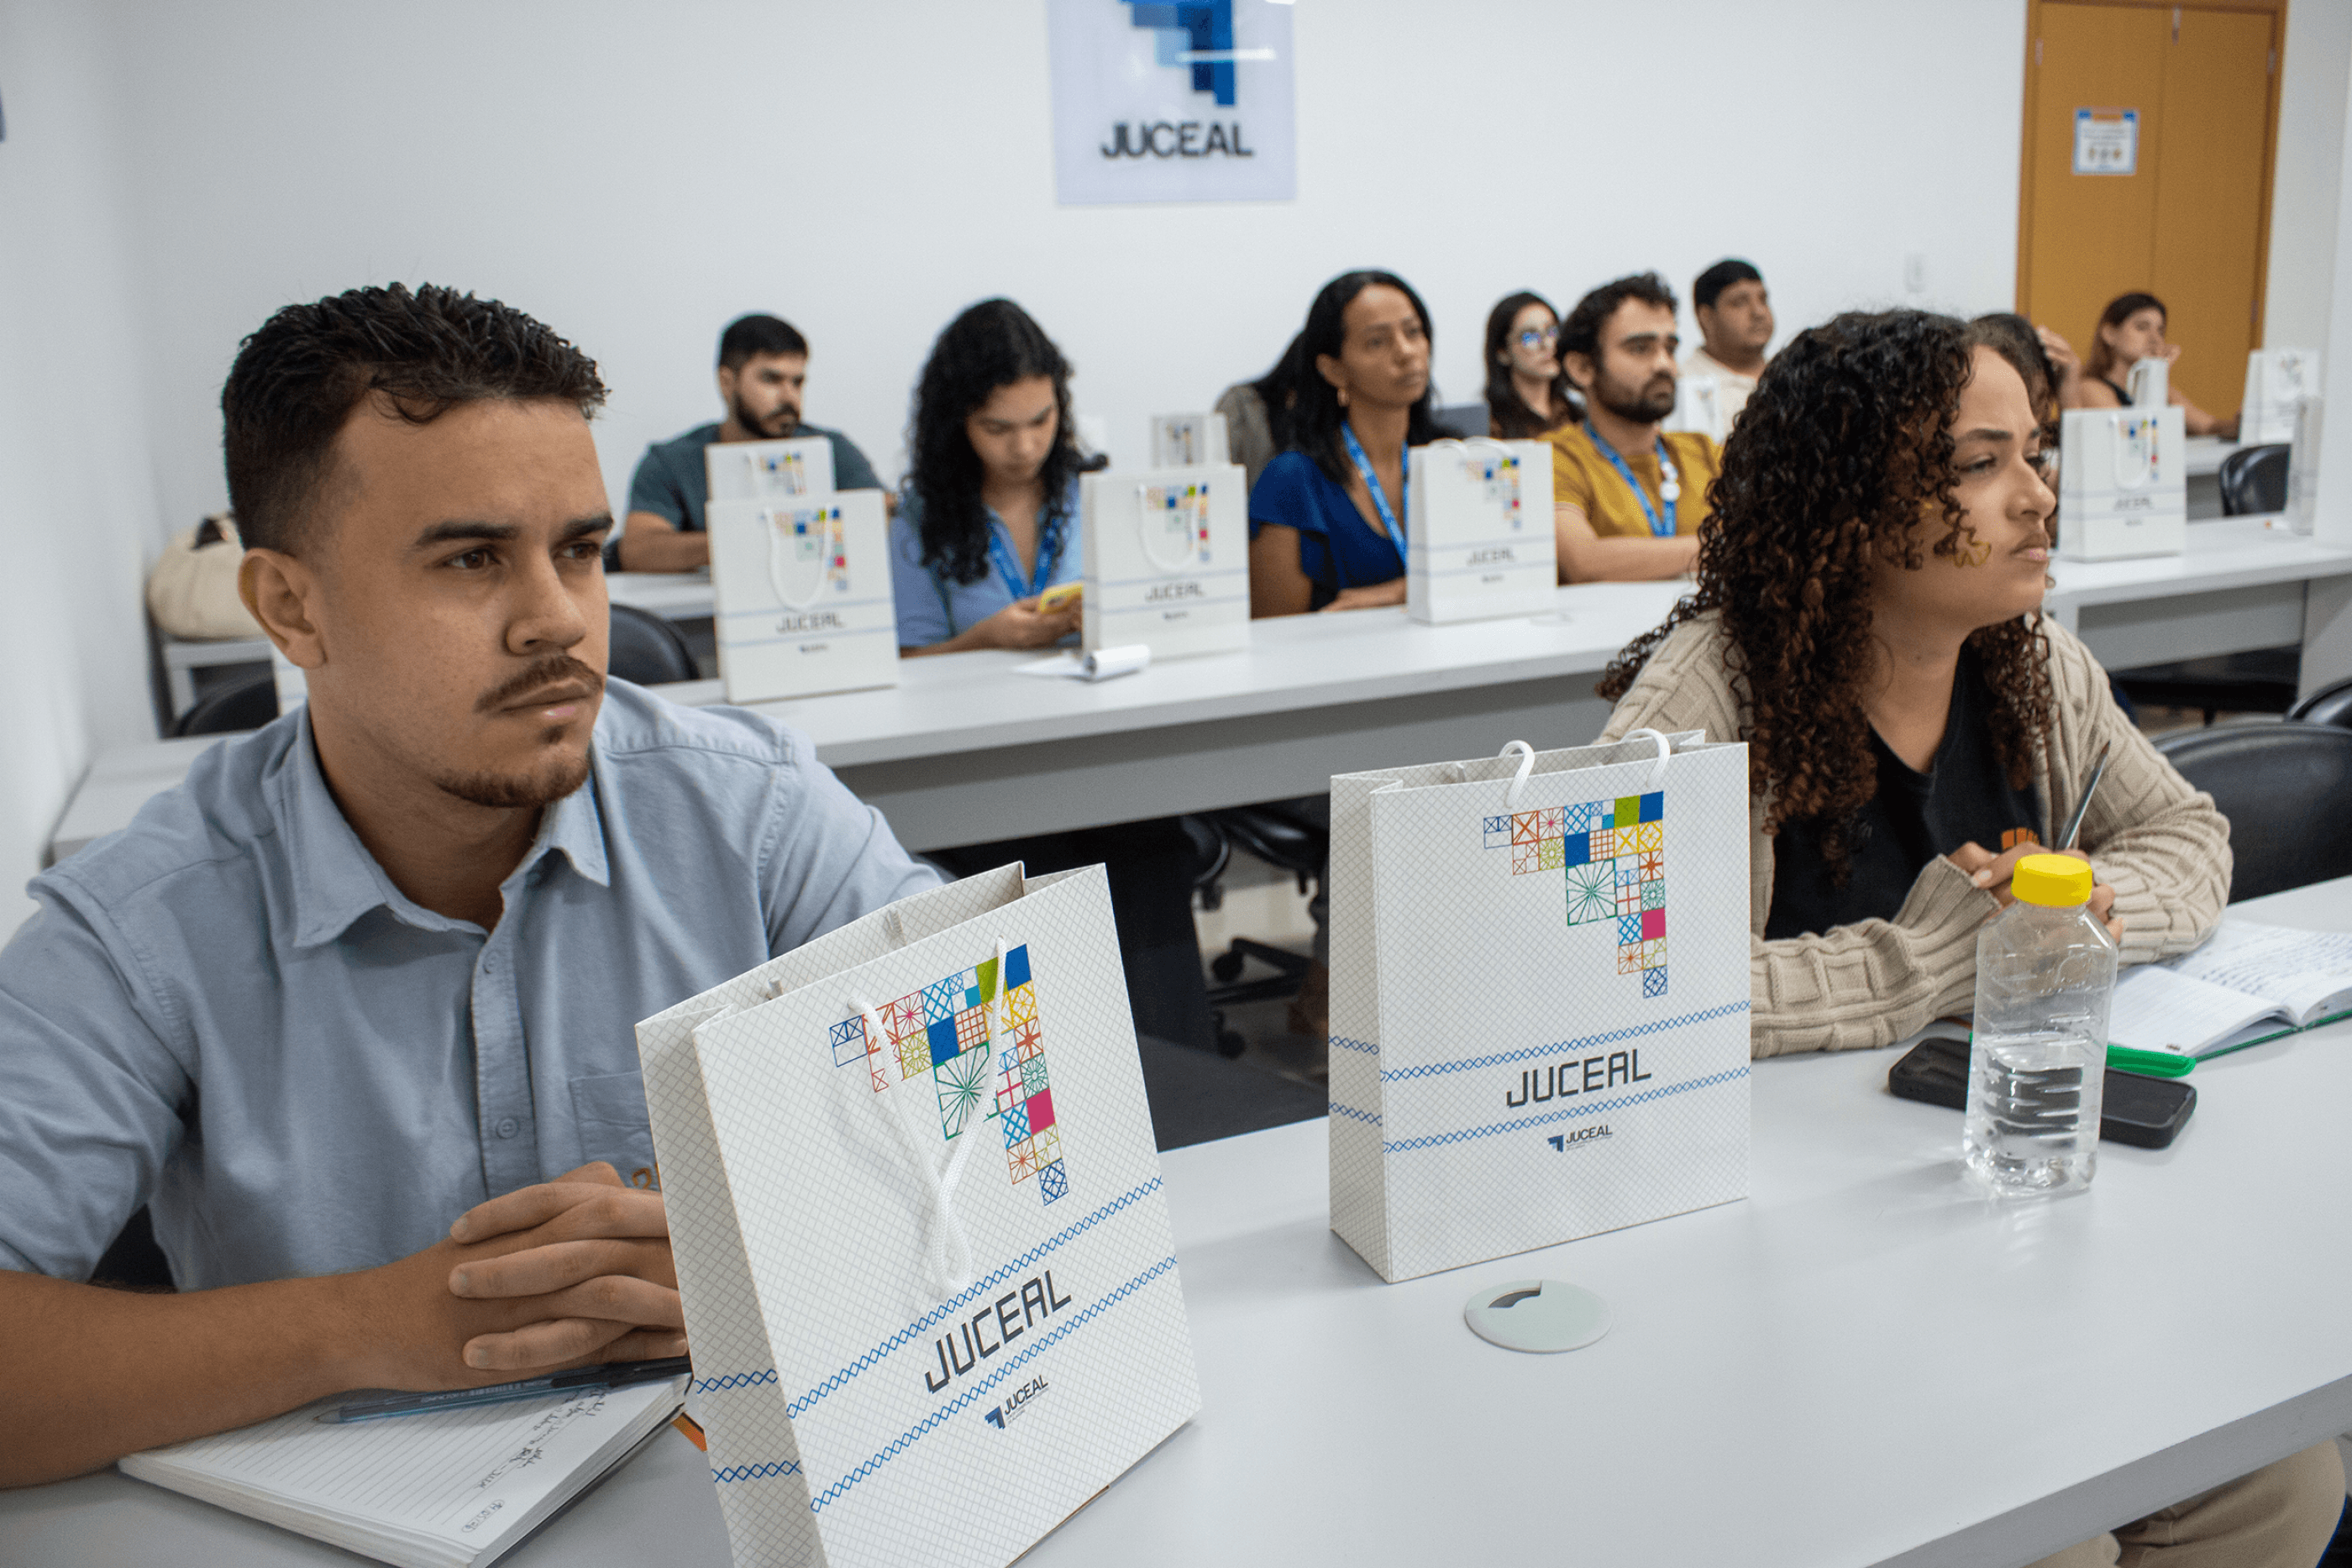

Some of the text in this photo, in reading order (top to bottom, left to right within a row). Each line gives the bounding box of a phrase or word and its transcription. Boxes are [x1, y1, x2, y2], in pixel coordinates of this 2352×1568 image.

[1101, 123, 1253, 158] JUCEAL
[1506, 1048, 1652, 1109] JUCEAL
[1566, 1125, 1613, 1144] JUCEAL
[925, 1271, 1072, 1393] JUCEAL
[1004, 1376, 1048, 1415] JUCEAL
